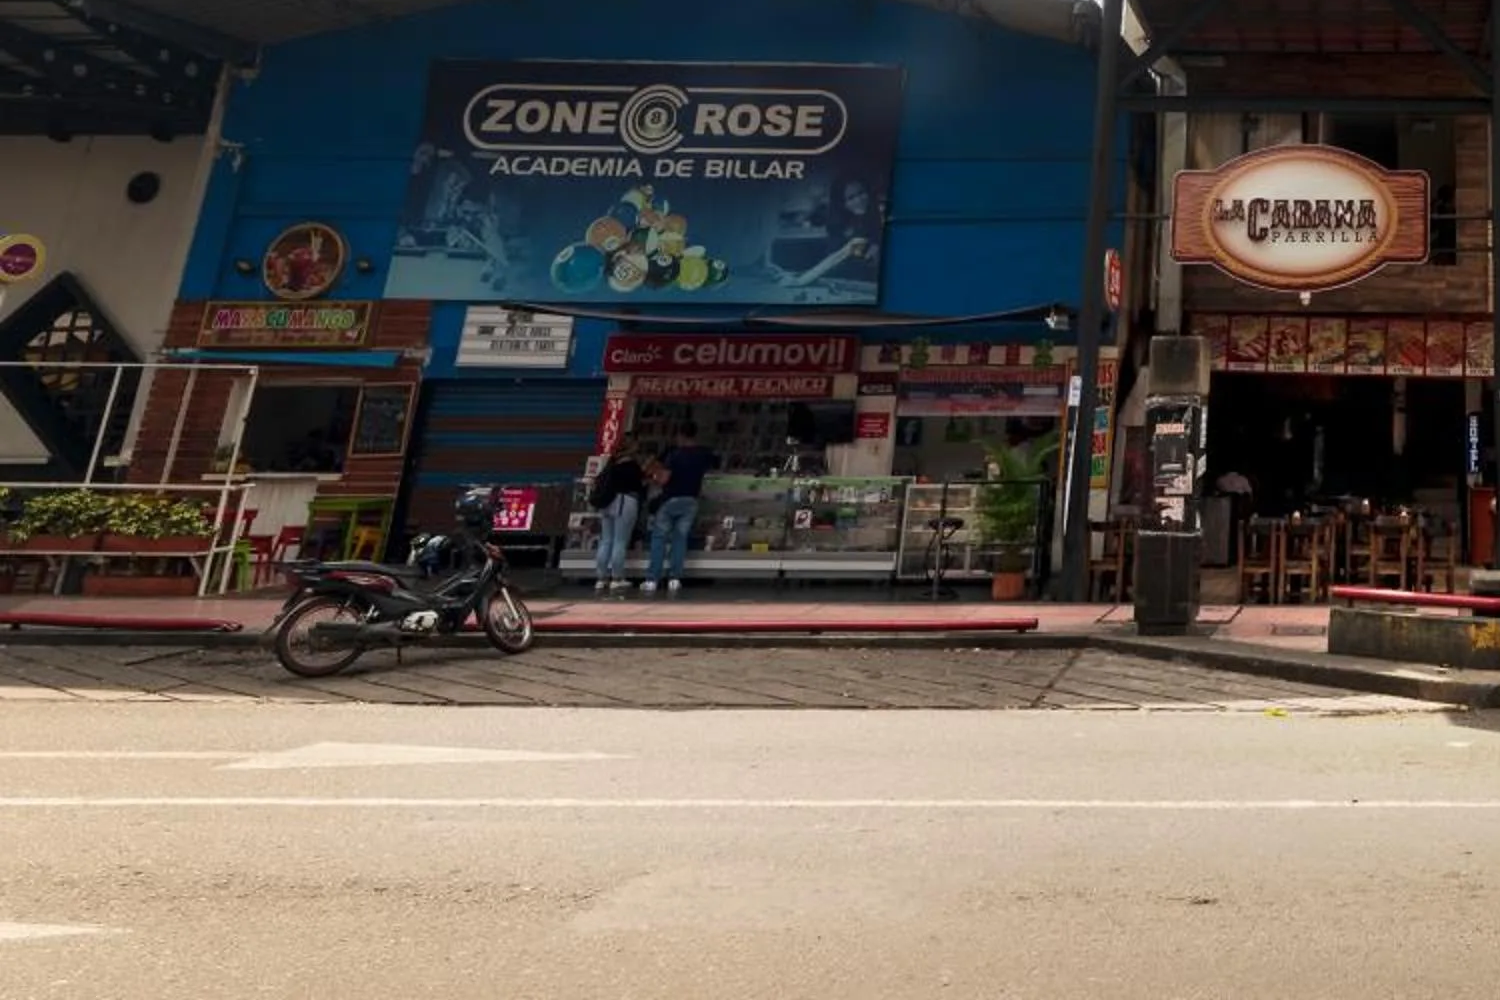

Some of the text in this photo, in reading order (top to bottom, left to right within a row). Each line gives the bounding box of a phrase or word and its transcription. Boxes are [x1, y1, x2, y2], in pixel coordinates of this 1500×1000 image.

[480, 99, 619, 135] ZONE
[693, 103, 825, 138] ROSE
[489, 156, 805, 180] ACADEMIA DE BILLAR
[1212, 198, 1245, 222] LA
[1271, 231, 1377, 243] PARRILLA
[610, 346, 654, 365] Claro
